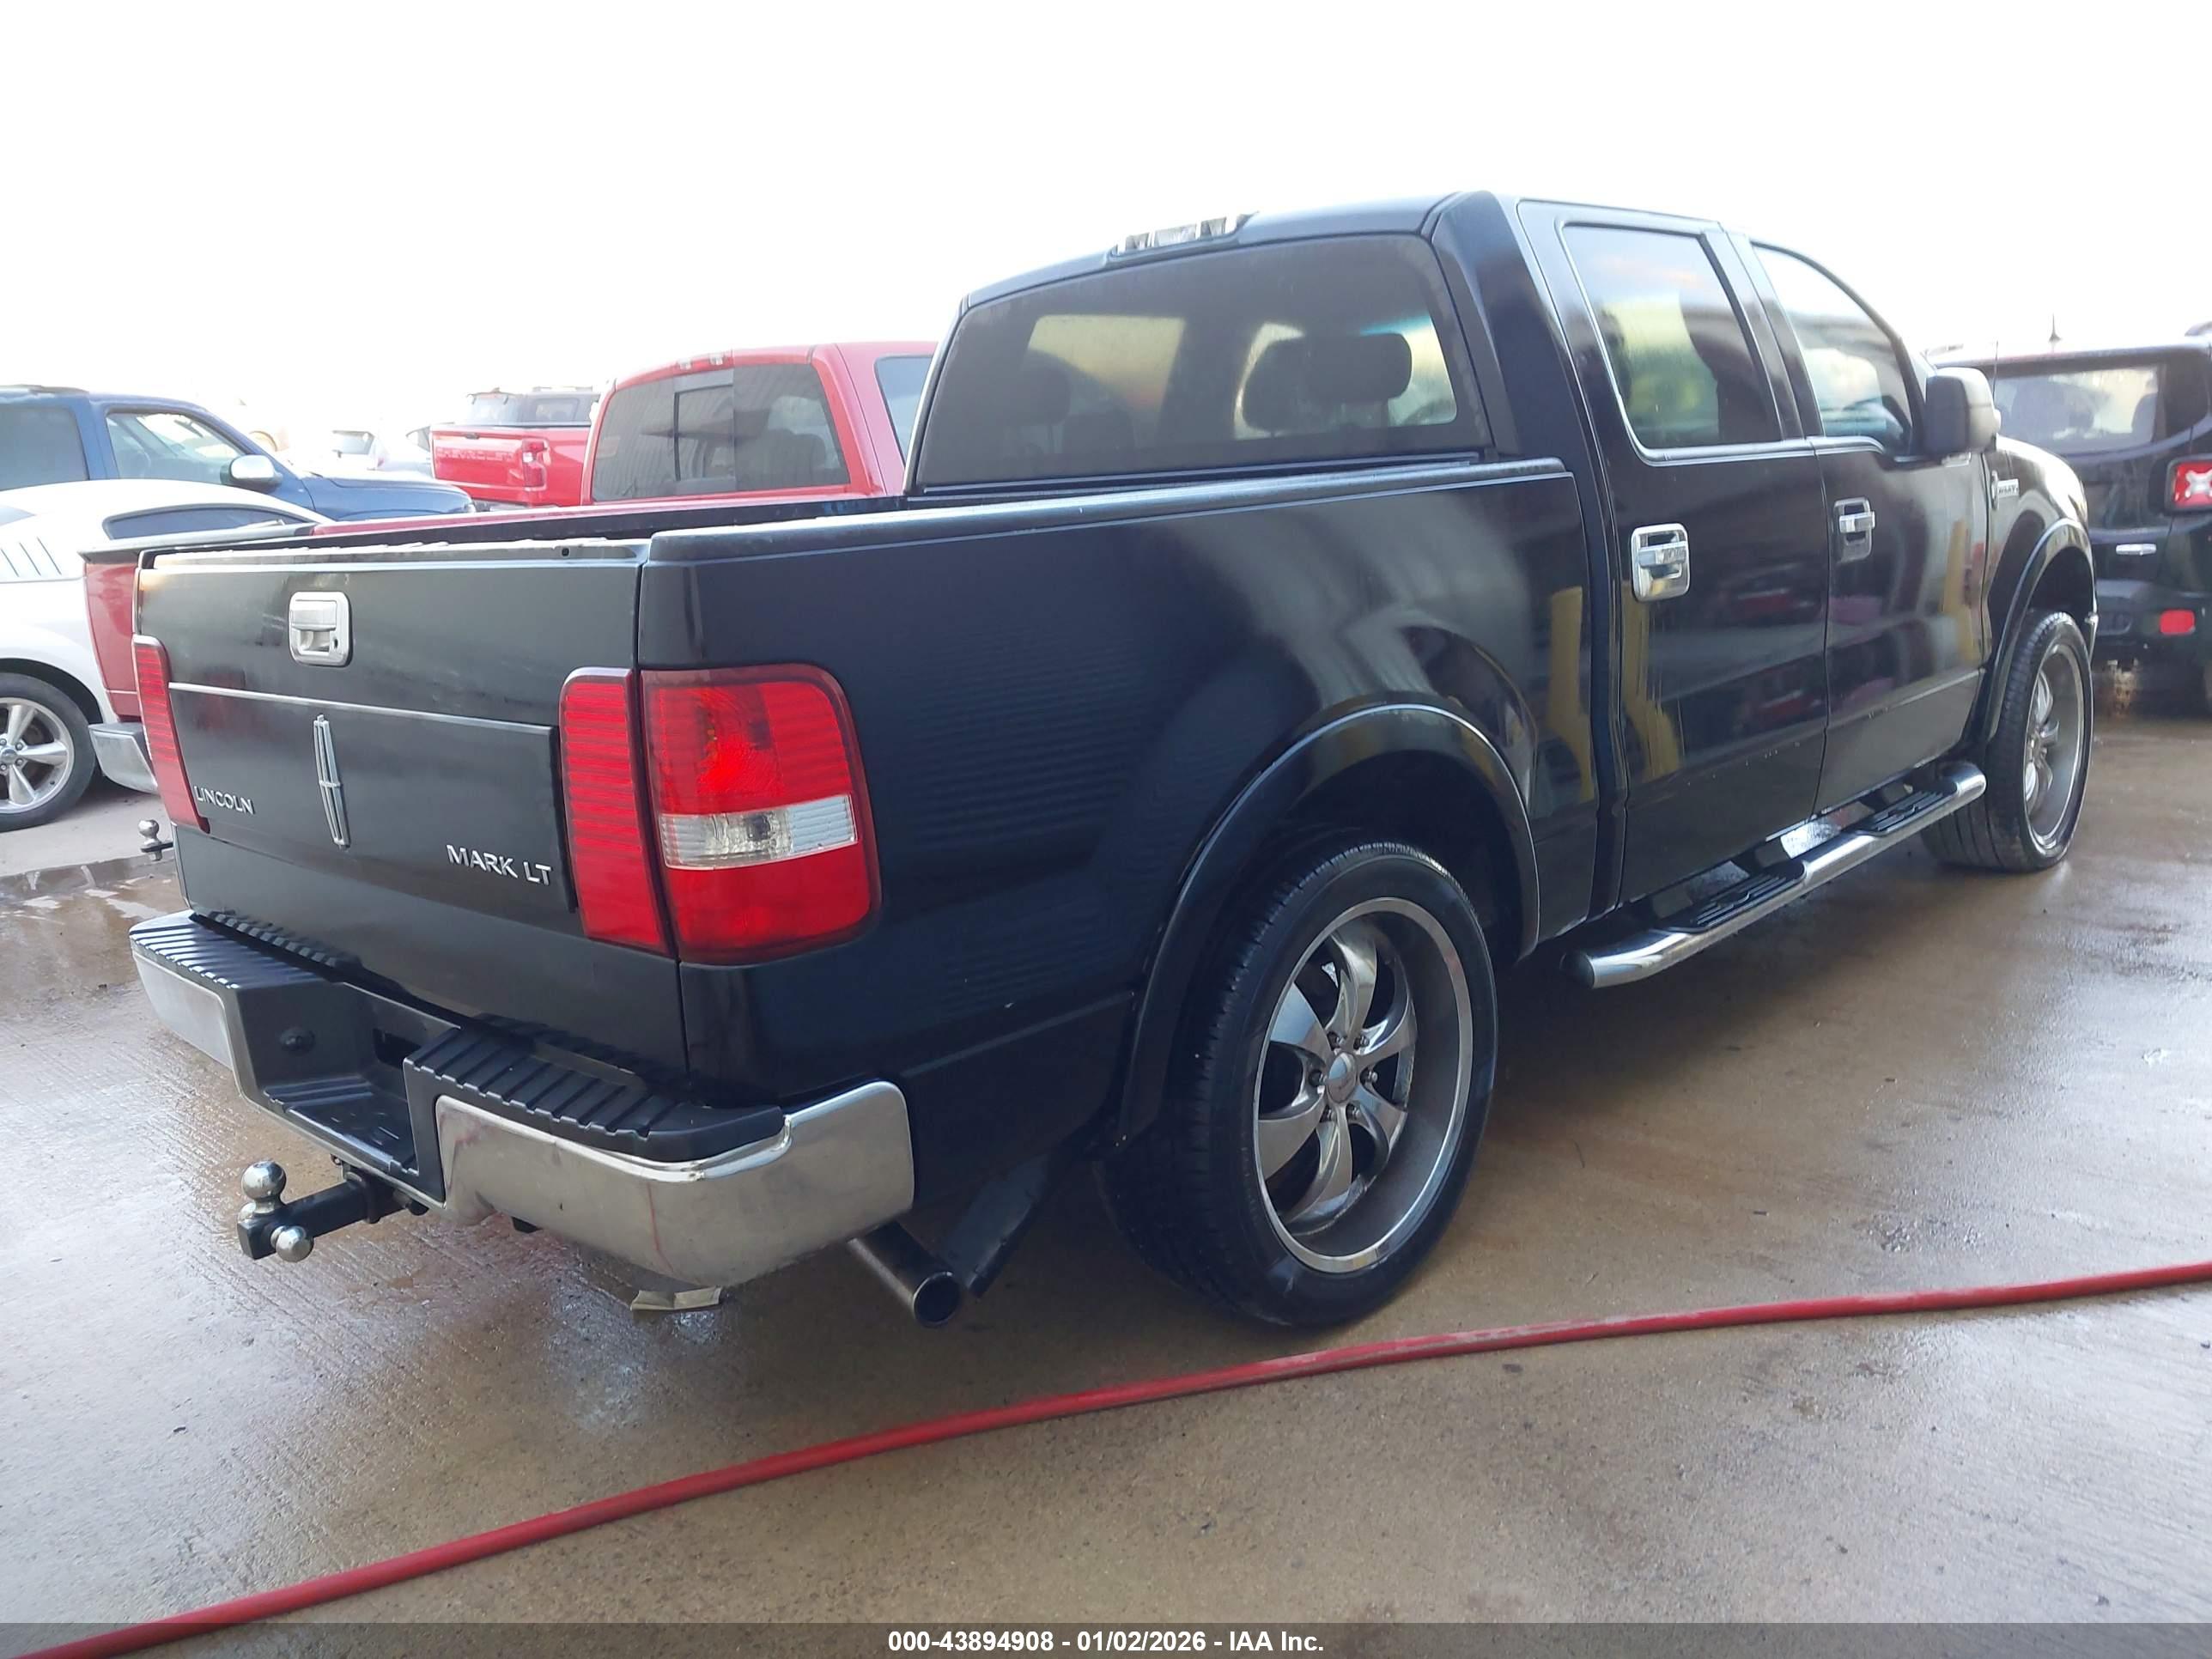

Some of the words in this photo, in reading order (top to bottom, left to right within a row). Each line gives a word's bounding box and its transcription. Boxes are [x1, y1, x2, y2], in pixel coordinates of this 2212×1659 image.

[193, 785, 255, 815] LINCOLN
[446, 844, 519, 878] MARK
[523, 861, 551, 885] LT
